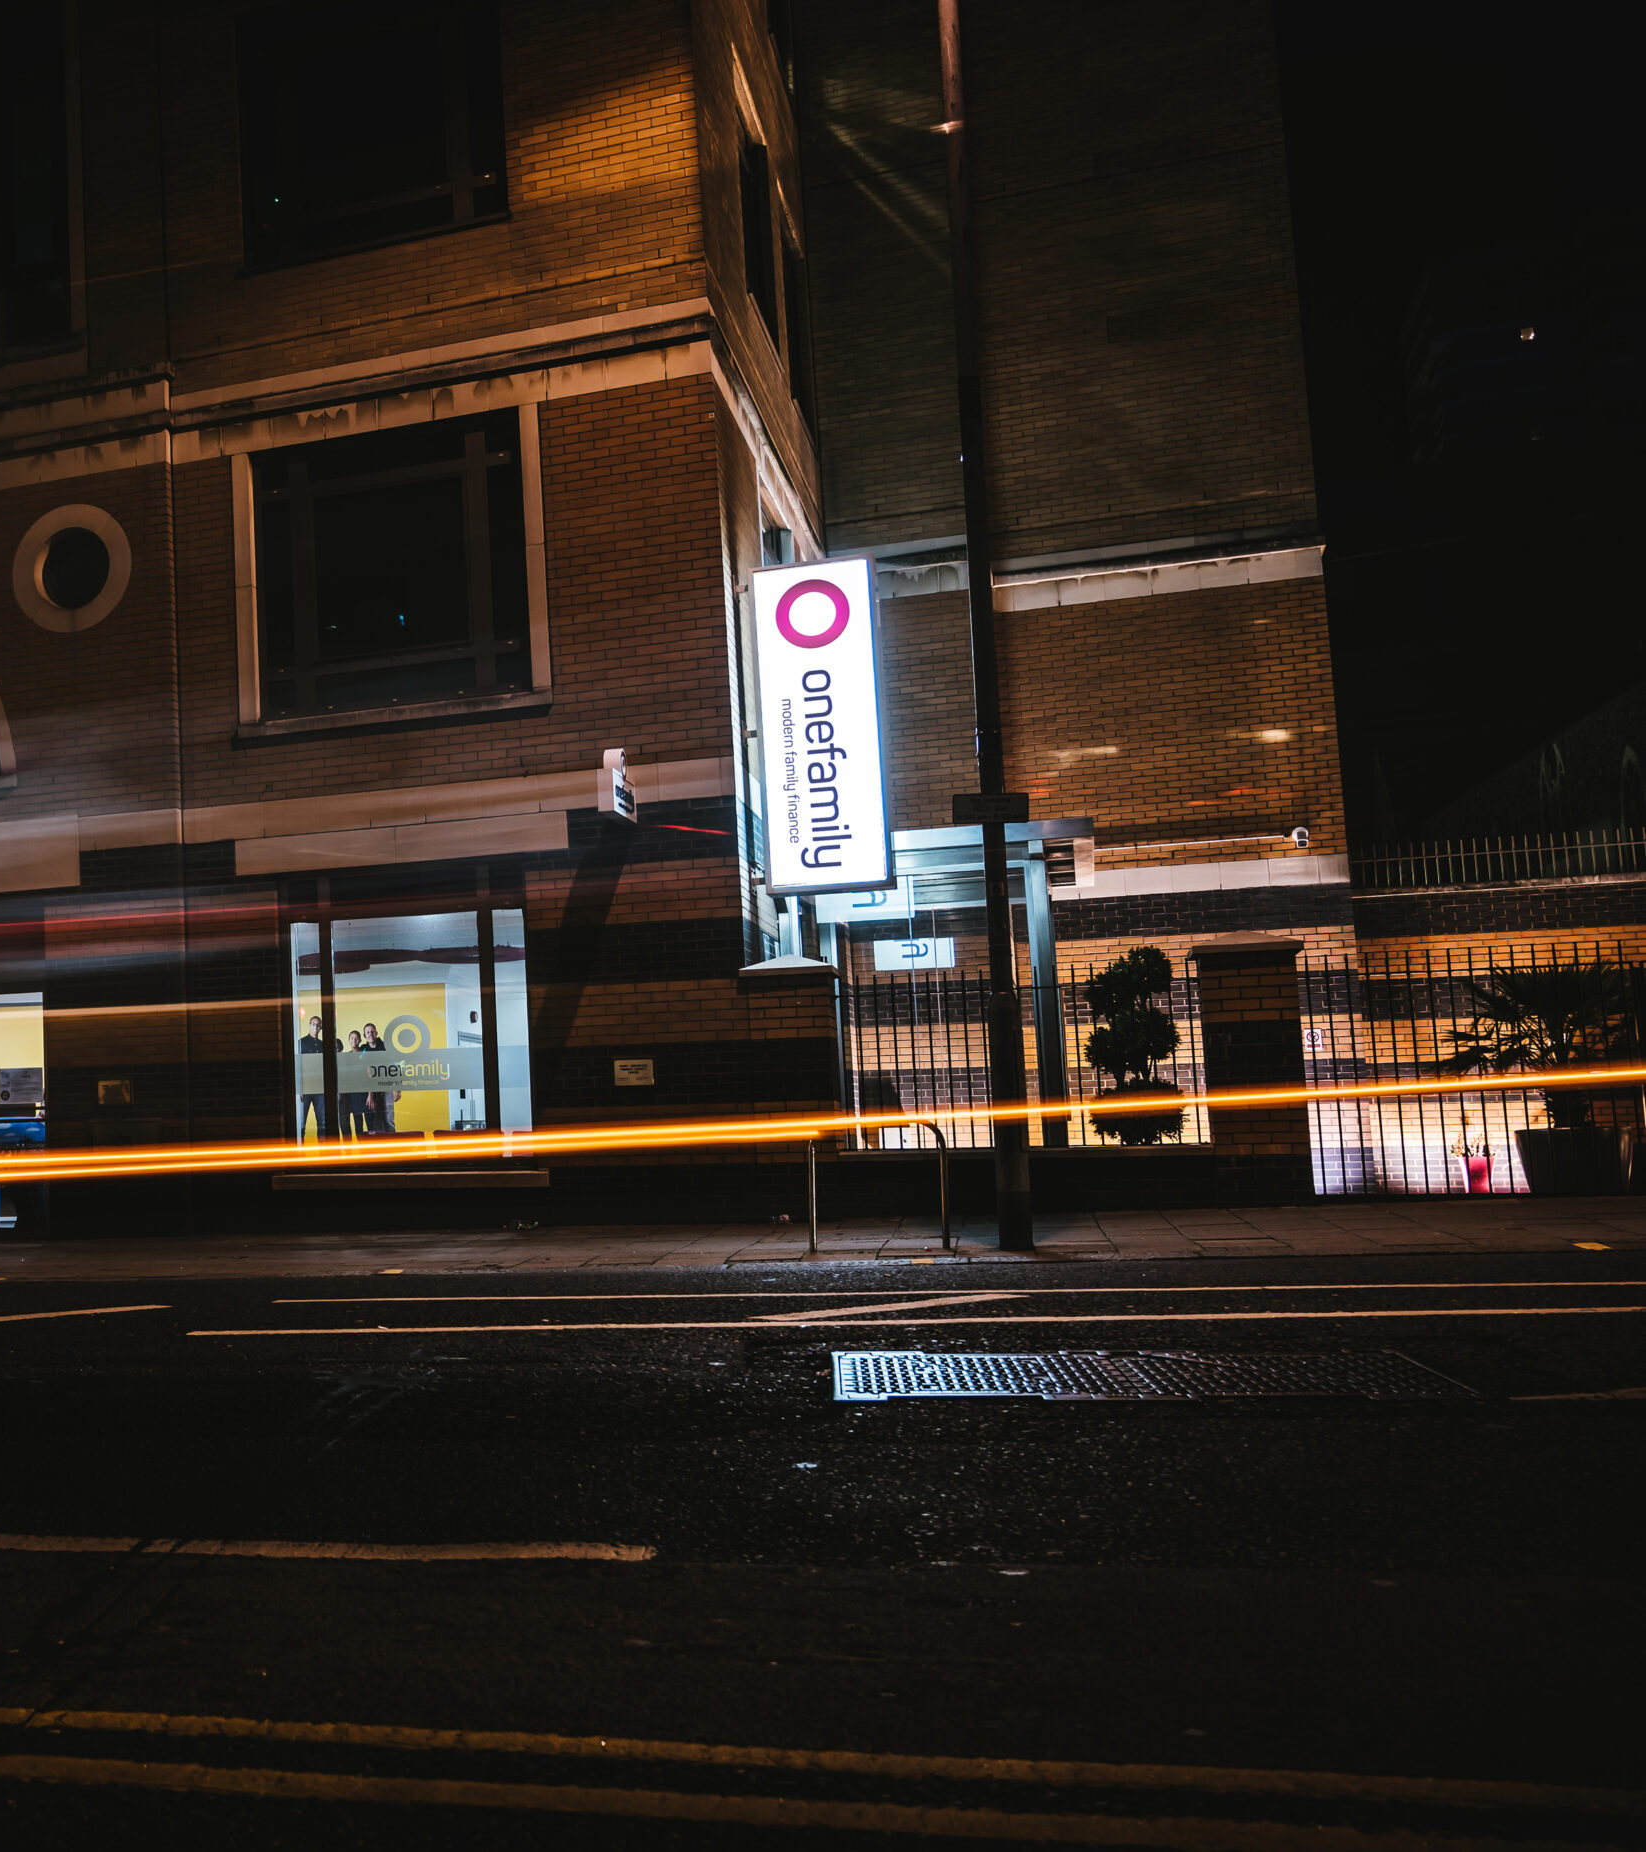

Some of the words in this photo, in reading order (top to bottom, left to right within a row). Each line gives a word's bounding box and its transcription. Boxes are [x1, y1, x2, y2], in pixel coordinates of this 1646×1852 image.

[781, 698, 796, 752] modern
[782, 751, 800, 792] family
[801, 669, 853, 868] onefamily
[787, 793, 800, 844] finance
[367, 1058, 450, 1080] onefamily
